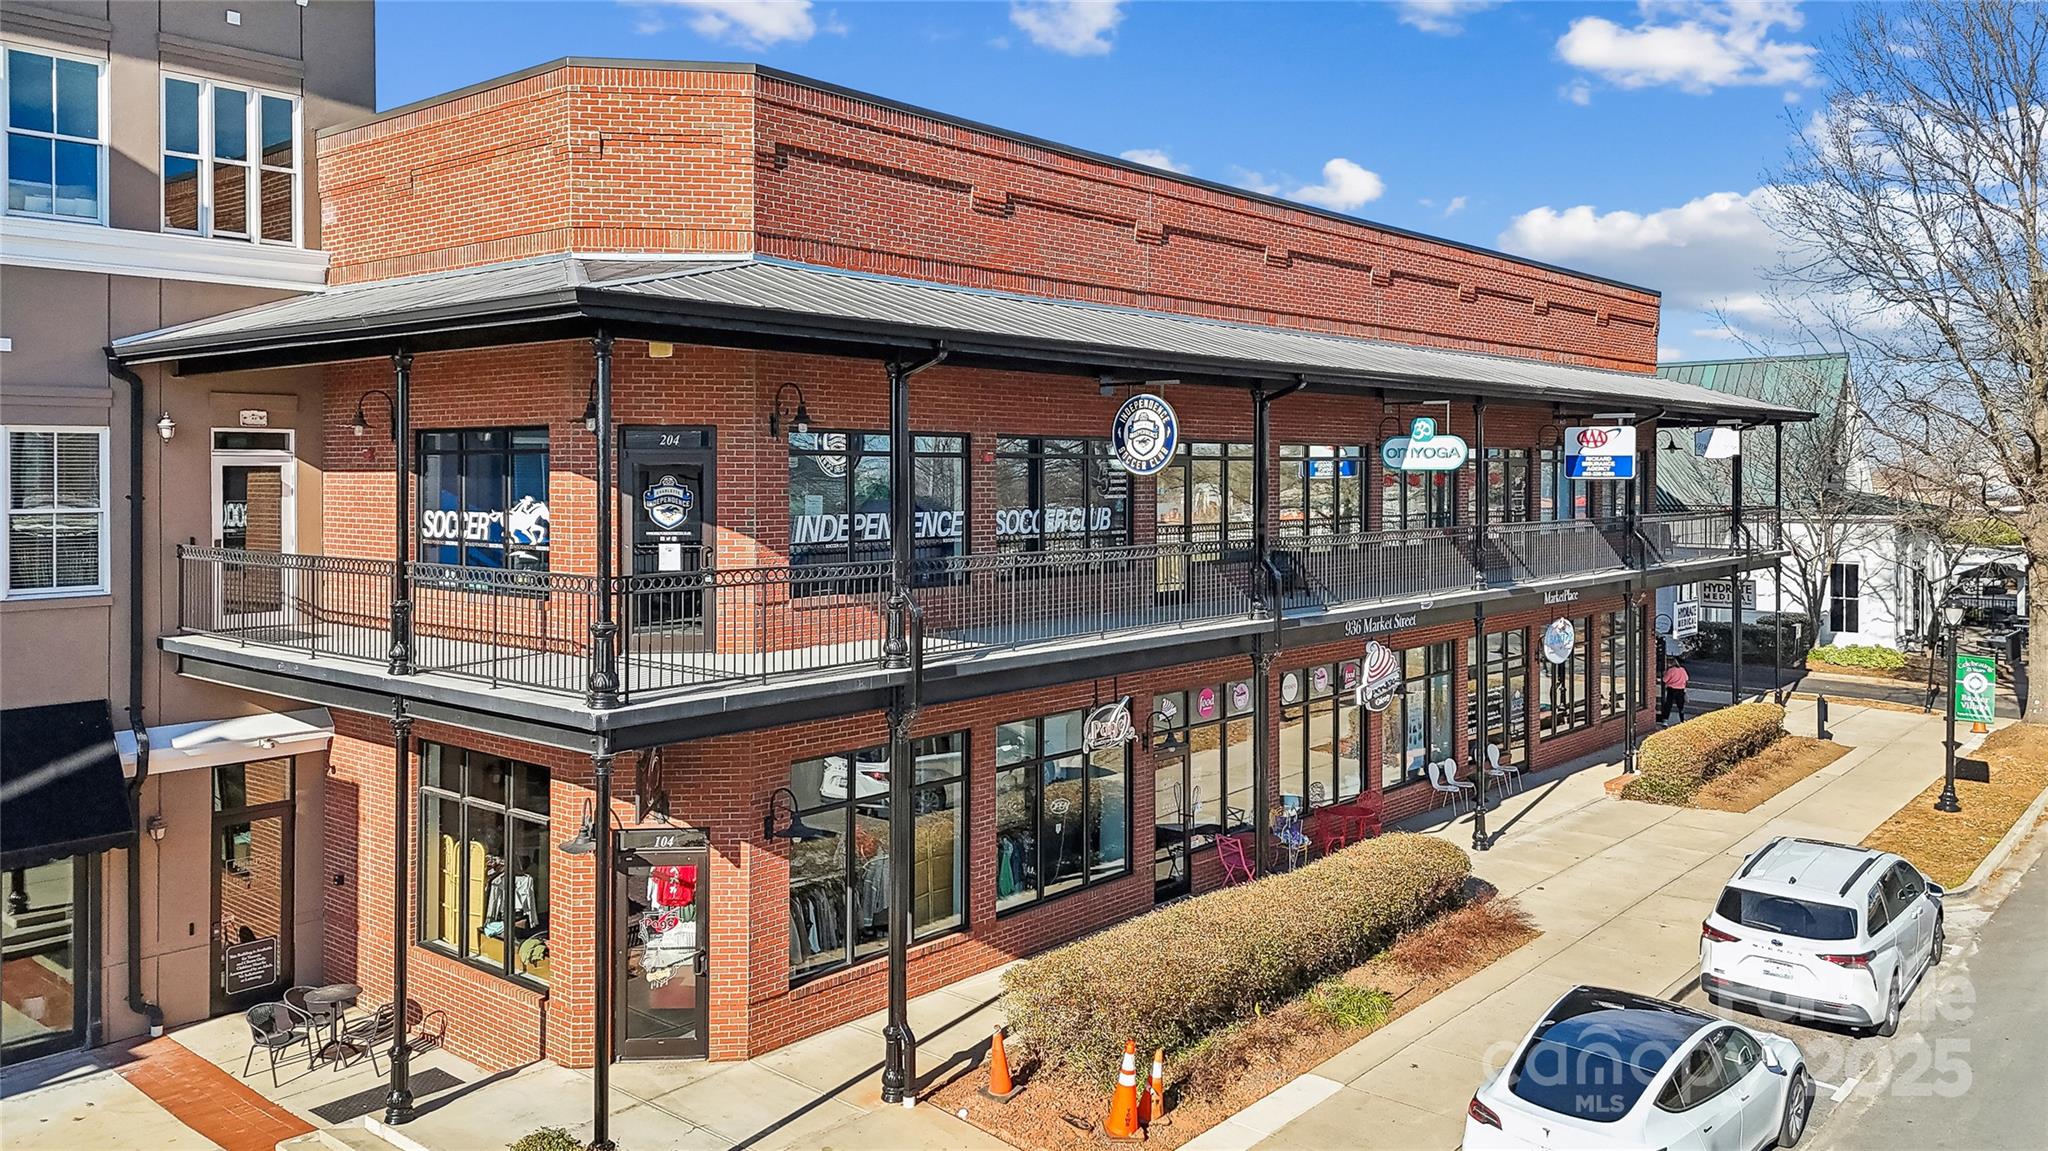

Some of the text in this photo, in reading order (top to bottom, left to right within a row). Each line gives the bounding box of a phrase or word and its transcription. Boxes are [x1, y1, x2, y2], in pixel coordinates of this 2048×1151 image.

[1118, 398, 1171, 424] INDEPENDENCE
[660, 434, 680, 445] 204
[1580, 429, 1606, 447] AAA
[1118, 446, 1169, 470] SOCCER CLUB
[646, 496, 691, 508] INDEPENDENCE
[794, 511, 965, 543] INDEPENENCE
[1703, 582, 1752, 594] HYDRTE
[1703, 593, 1752, 602] MEDIAL
[1345, 613, 1417, 637] 936 Market Street
[1344, 669, 1356, 683] food
[1200, 694, 1215, 711] food
[654, 836, 675, 847] 104
[644, 917, 675, 930] Page
